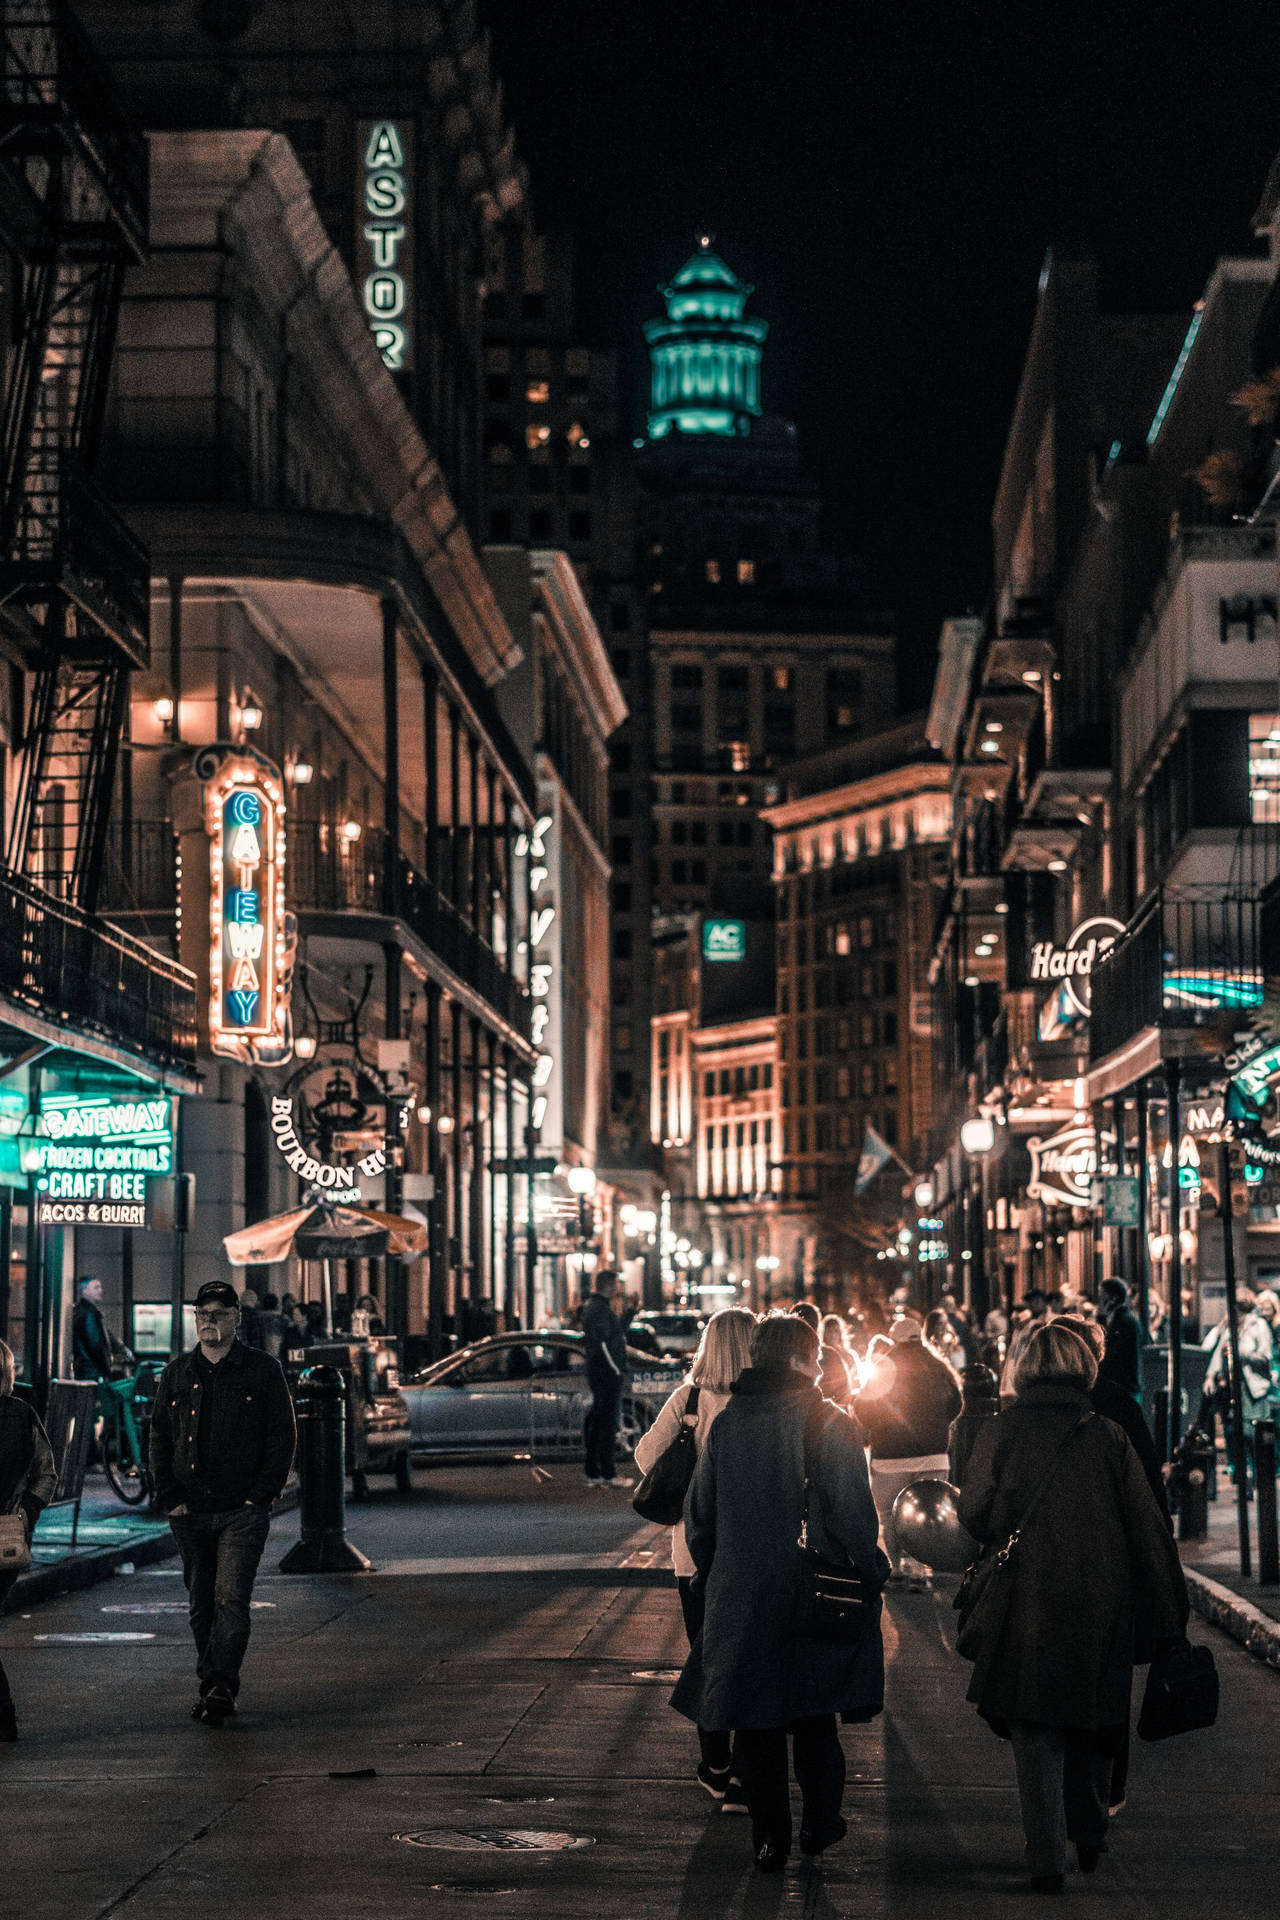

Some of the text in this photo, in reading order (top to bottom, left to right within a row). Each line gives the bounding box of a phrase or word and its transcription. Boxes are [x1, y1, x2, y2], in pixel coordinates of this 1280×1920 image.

[364, 121, 406, 369] ASTOR
[228, 792, 265, 1025] GATEWAY
[708, 924, 739, 944] AC
[1031, 938, 1097, 978] Hard
[42, 1100, 168, 1140] GATEWAY
[39, 1145, 170, 1171] FROZEN COCKTAILS
[271, 1096, 355, 1188] BOURBON
[49, 1172, 107, 1199] CRAFT
[41, 1204, 85, 1222] ACOS
[101, 1205, 145, 1223] BURRI
